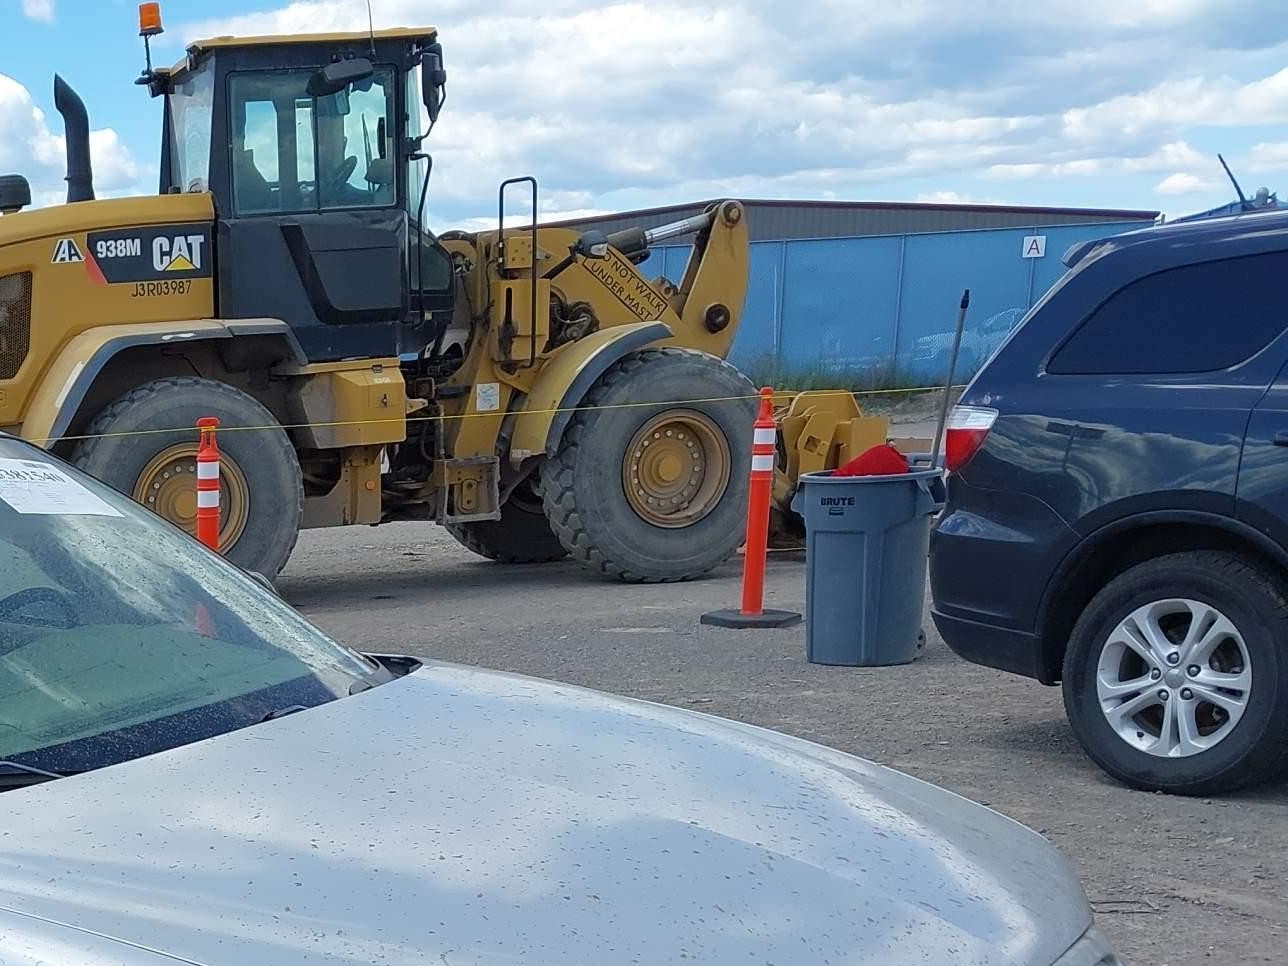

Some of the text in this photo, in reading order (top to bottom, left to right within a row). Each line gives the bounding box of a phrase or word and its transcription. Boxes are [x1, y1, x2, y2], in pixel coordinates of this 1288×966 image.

[96, 238, 141, 259] 938M
[152, 234, 205, 272] CAT
[1026, 238, 1040, 256] A
[590, 262, 653, 320] UNDER MAST
[611, 261, 636, 284] NOT
[636, 281, 664, 313] WALK
[820, 496, 856, 506] BRUTE
